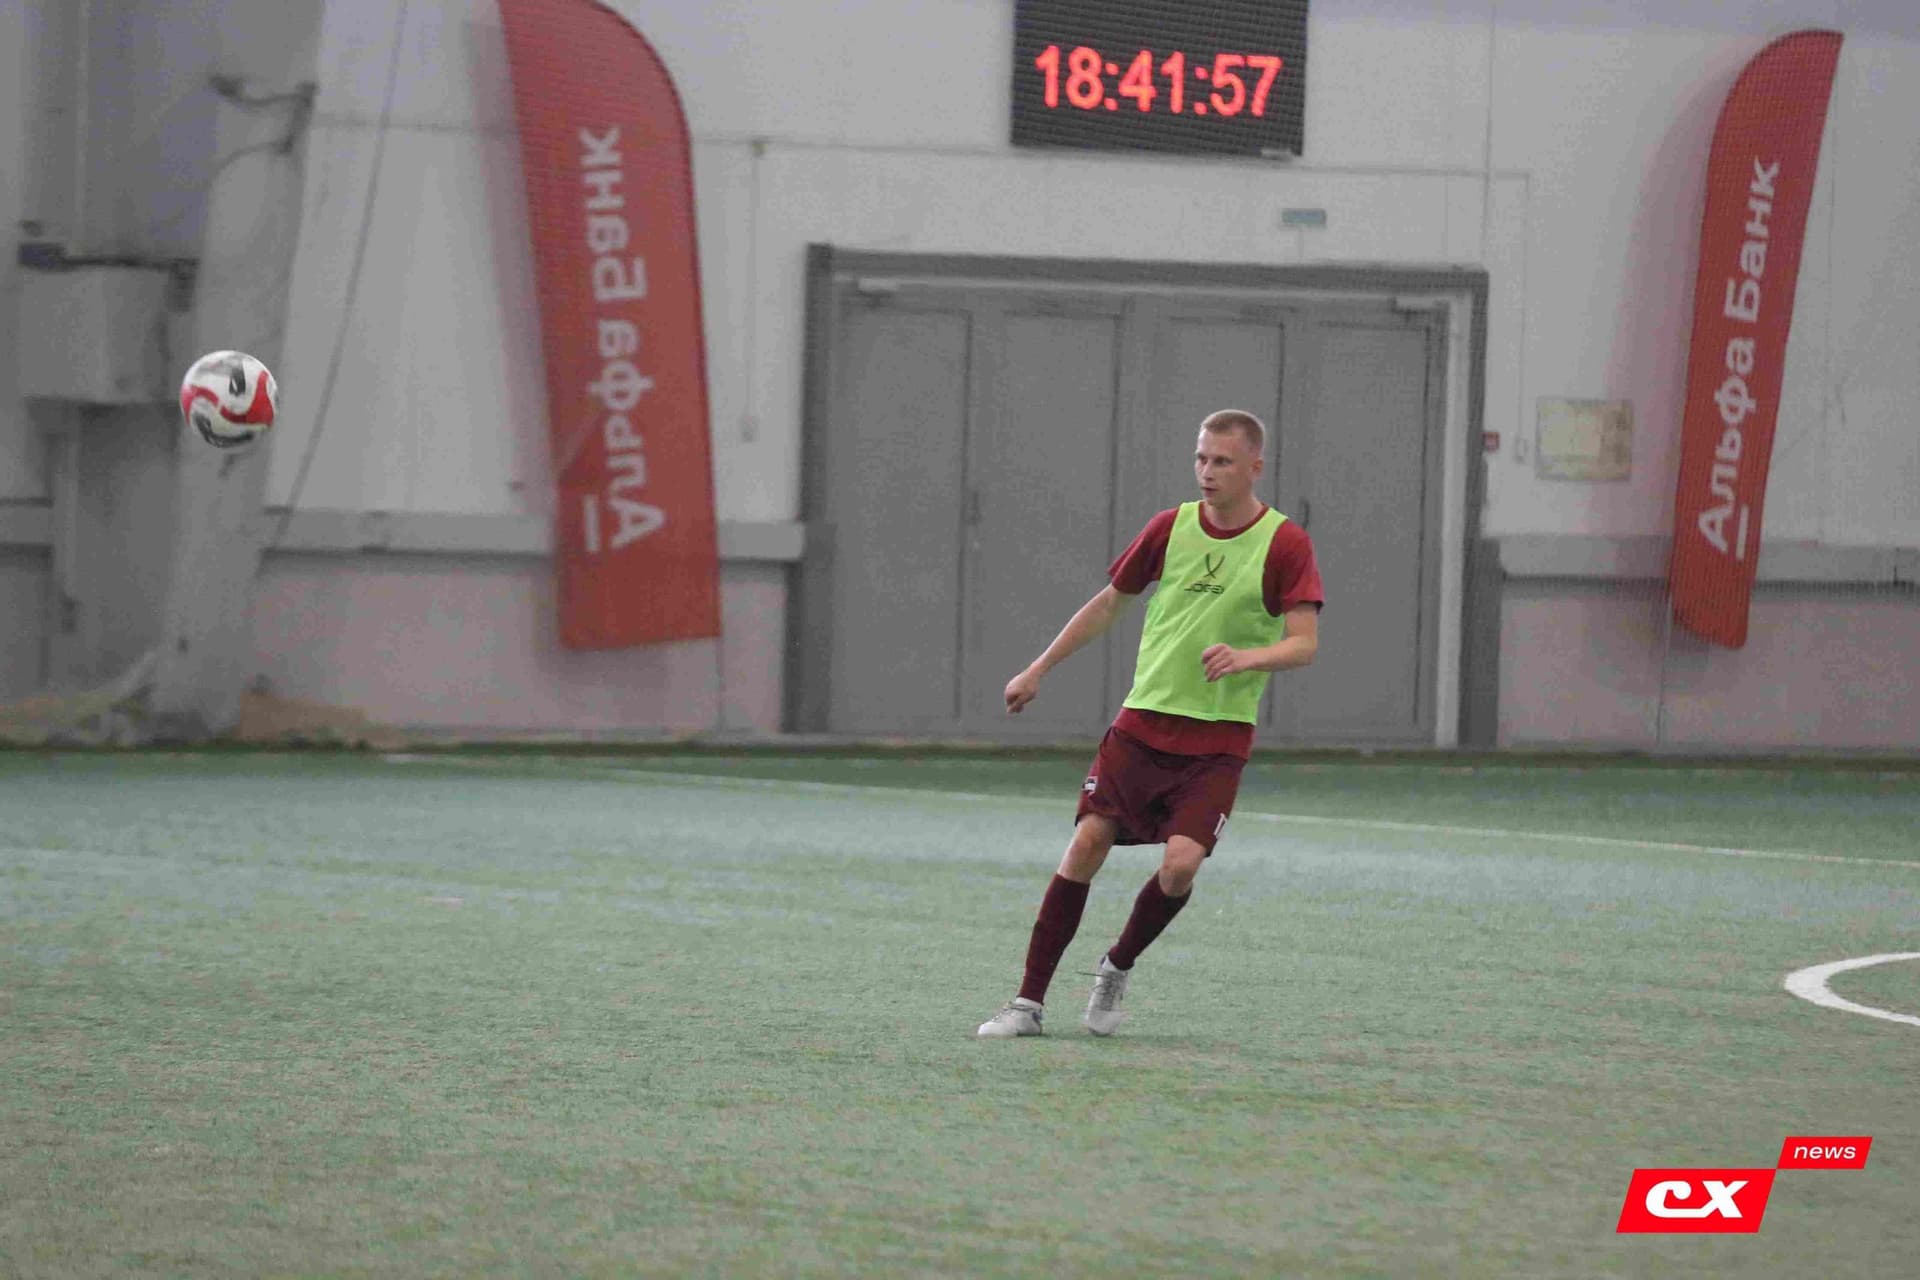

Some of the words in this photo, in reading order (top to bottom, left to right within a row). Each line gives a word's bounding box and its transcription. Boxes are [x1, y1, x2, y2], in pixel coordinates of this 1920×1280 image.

[1035, 45, 1282, 116] 18:41:57
[1724, 155, 1781, 323] Банк
[1699, 338, 1757, 551] Альфа
